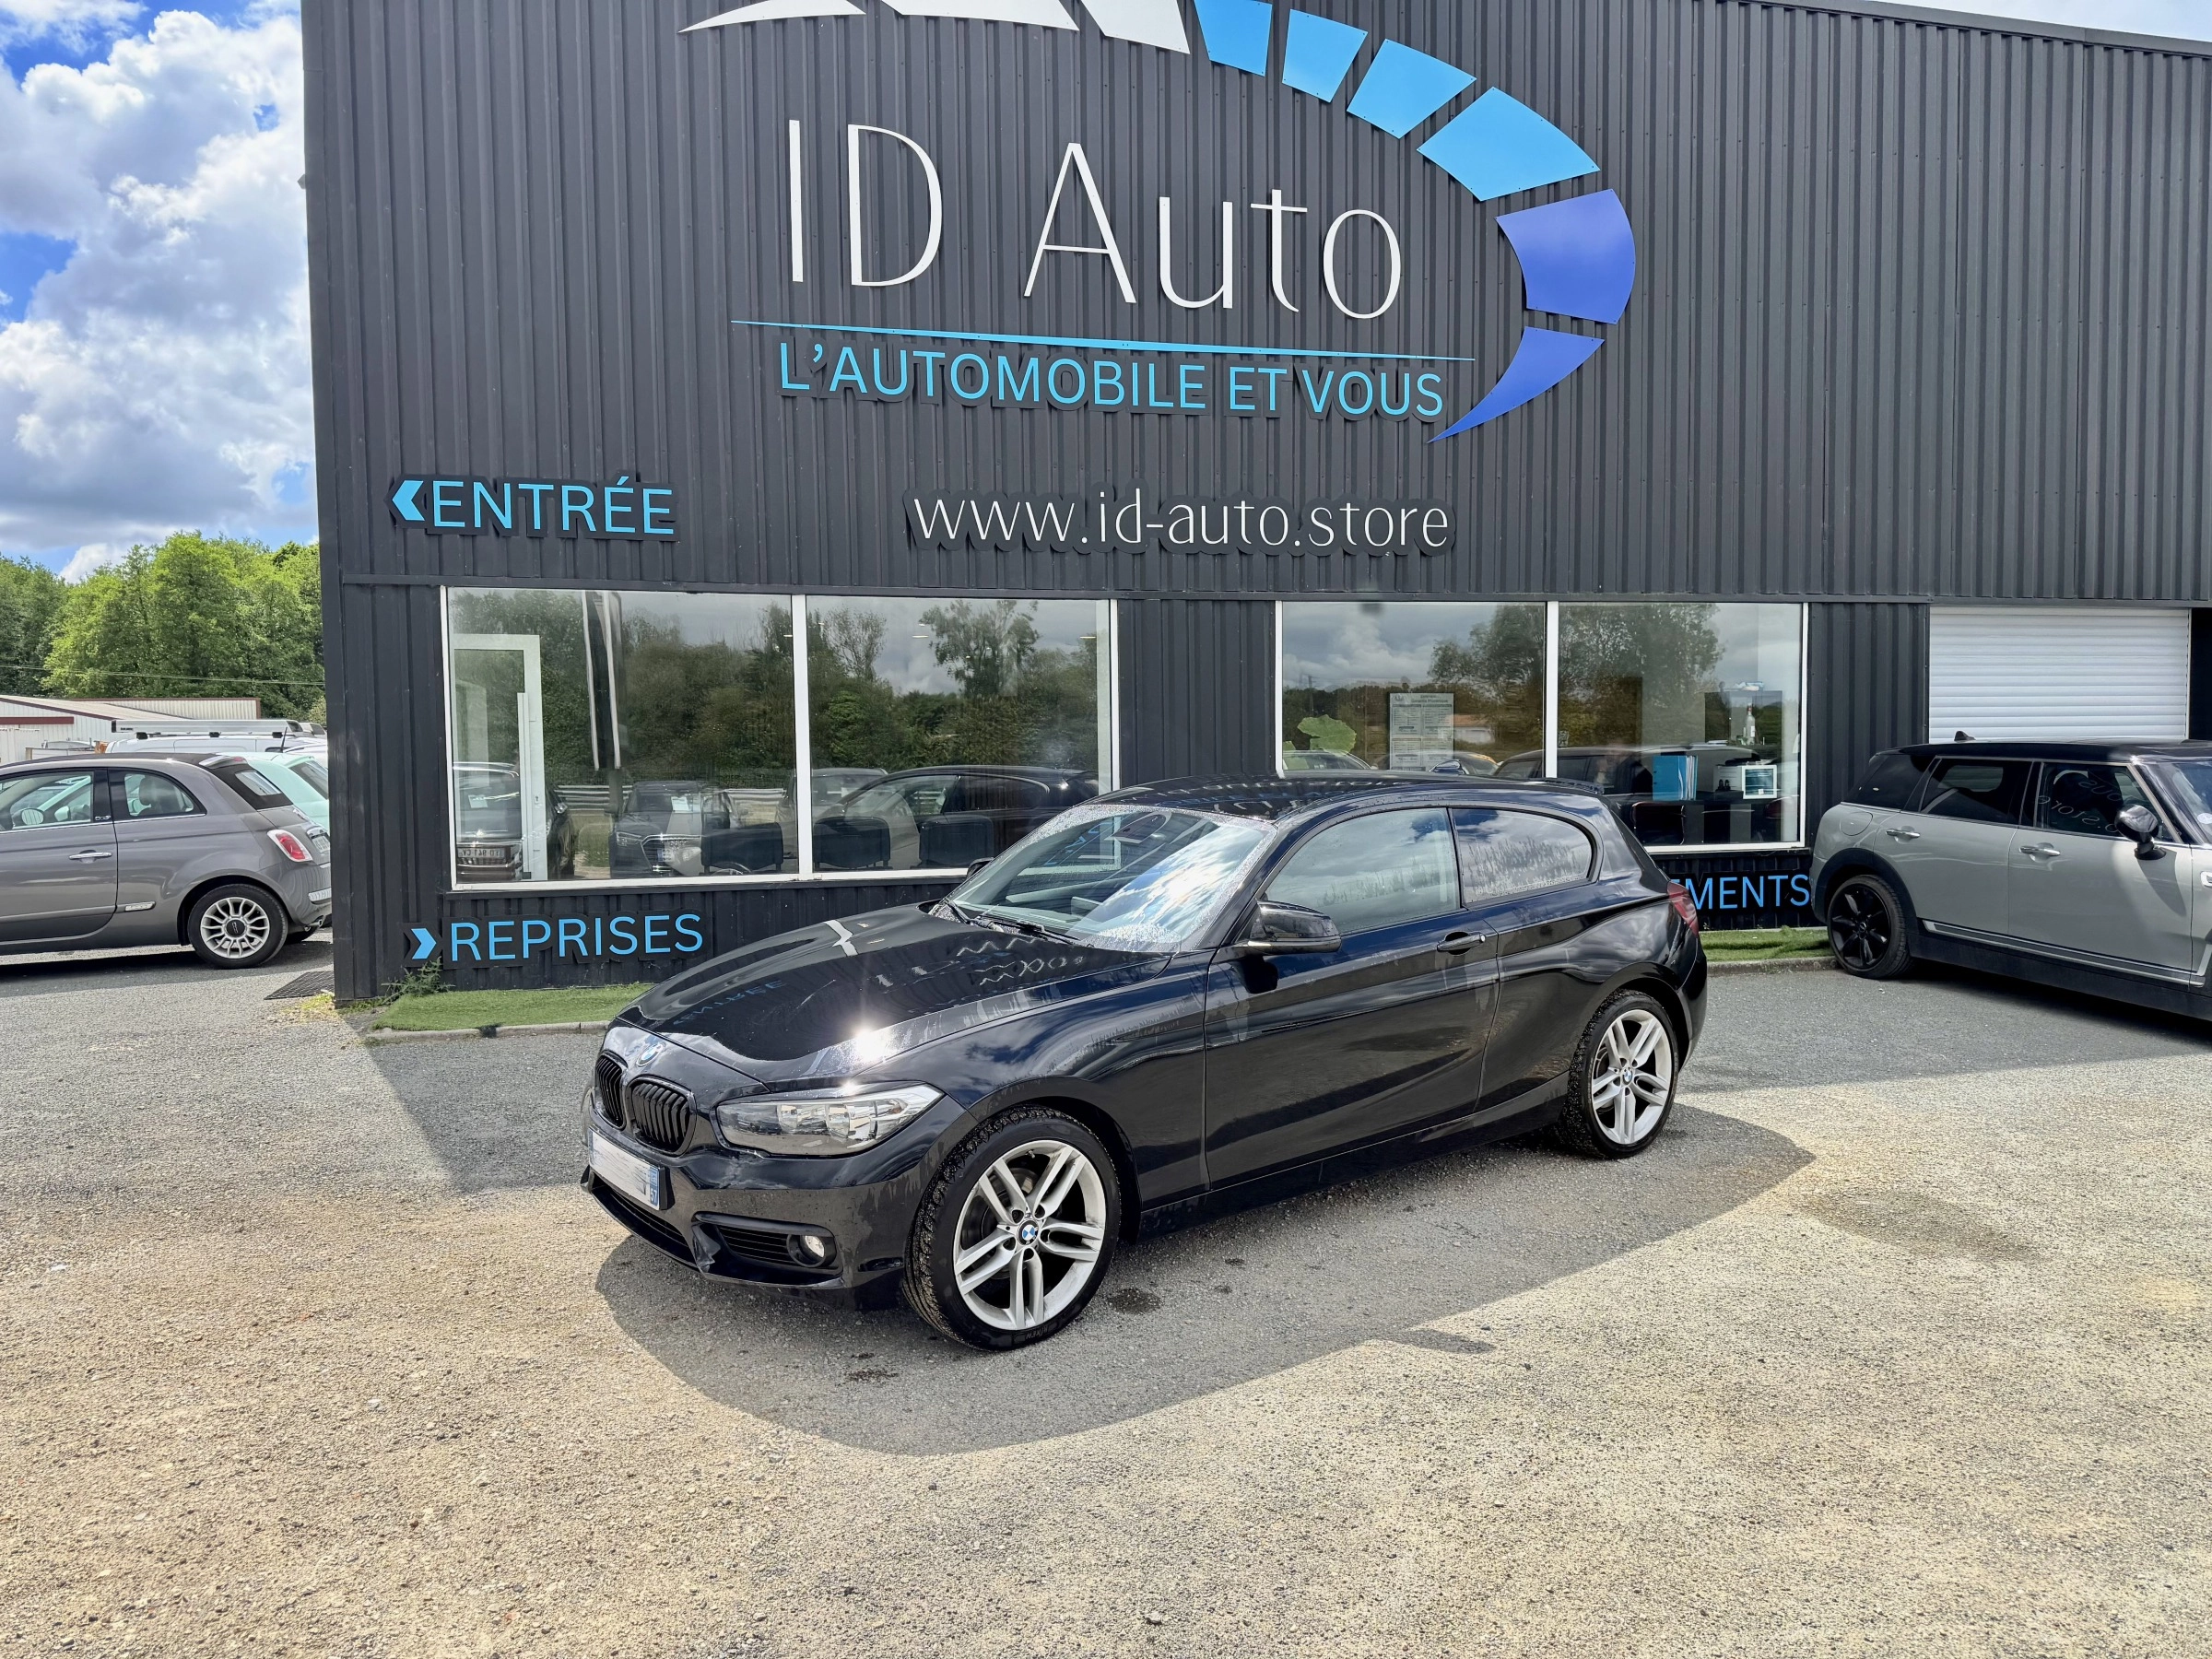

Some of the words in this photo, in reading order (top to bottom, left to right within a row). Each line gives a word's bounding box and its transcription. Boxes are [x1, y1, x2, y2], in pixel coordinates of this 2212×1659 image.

[788, 119, 943, 288] ID
[1023, 142, 1402, 320] Auto
[1230, 366, 1288, 411] ET
[1302, 370, 1443, 417] VOUS
[432, 476, 675, 535] ENTRÉE
[913, 488, 1448, 547] www.id-auto.store
[1671, 874, 1810, 910] MENTS
[451, 913, 703, 961] REPRISES
